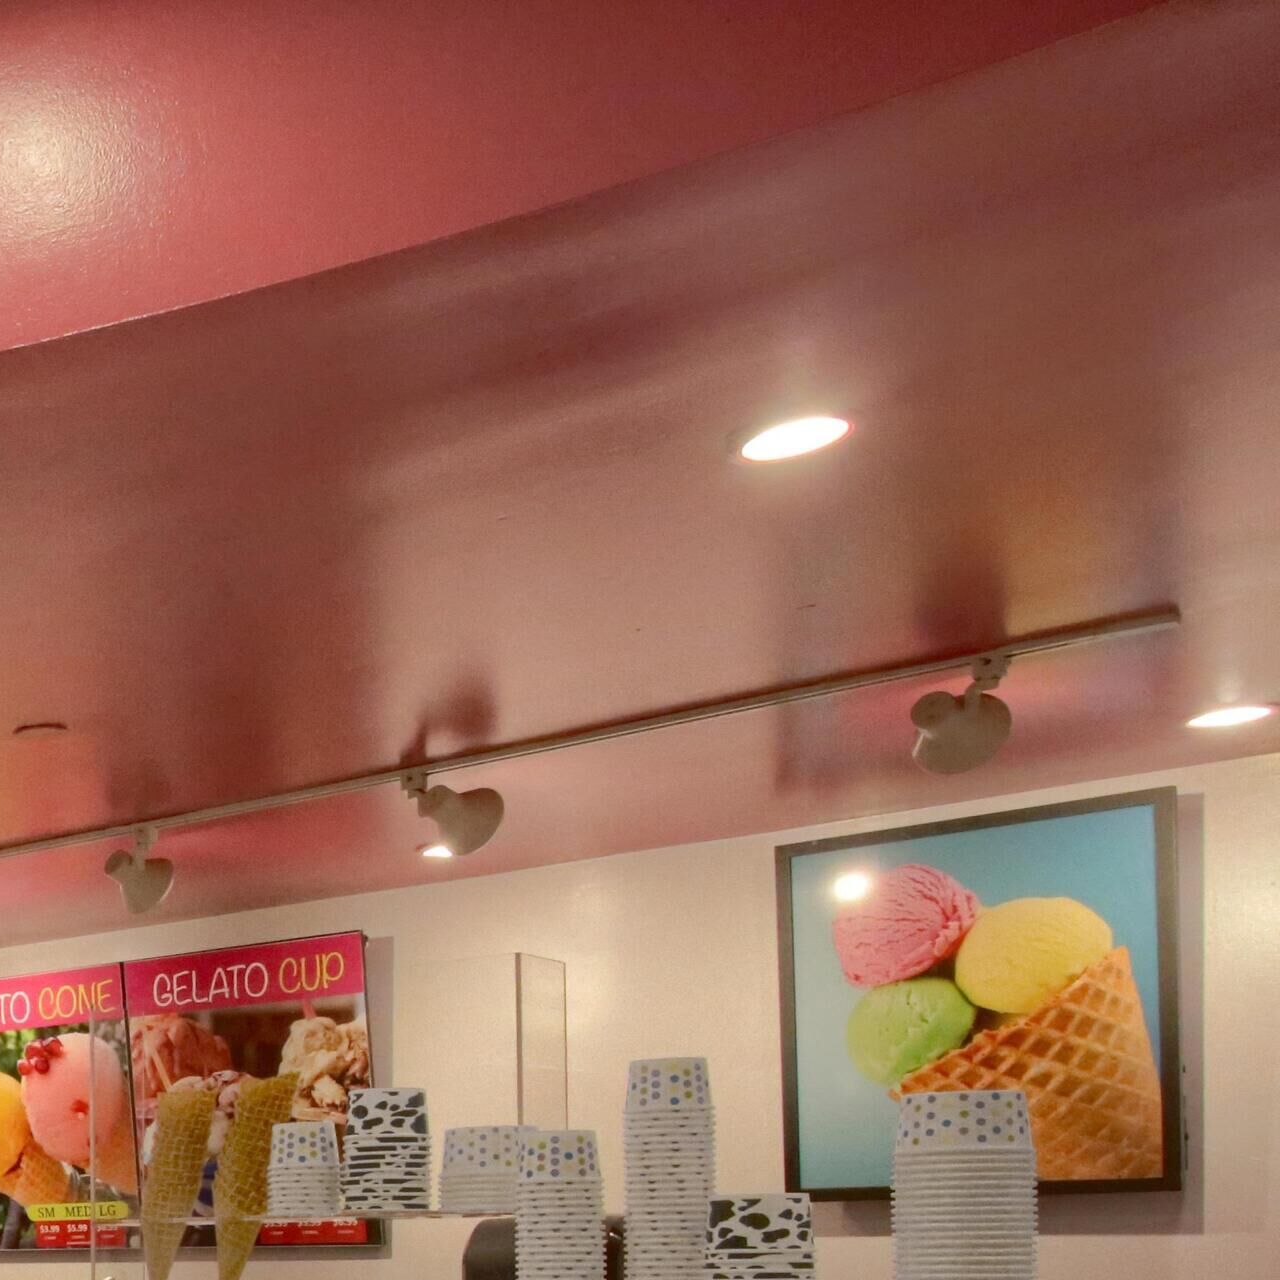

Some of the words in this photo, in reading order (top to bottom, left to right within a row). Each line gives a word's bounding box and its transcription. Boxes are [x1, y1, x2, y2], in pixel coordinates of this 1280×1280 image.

[39, 979, 116, 1021] CONE
[153, 962, 268, 1006] GELATO
[279, 952, 344, 993] CUP
[38, 1207, 55, 1218] SM
[65, 1205, 92, 1217] MED
[100, 1204, 116, 1216] LG
